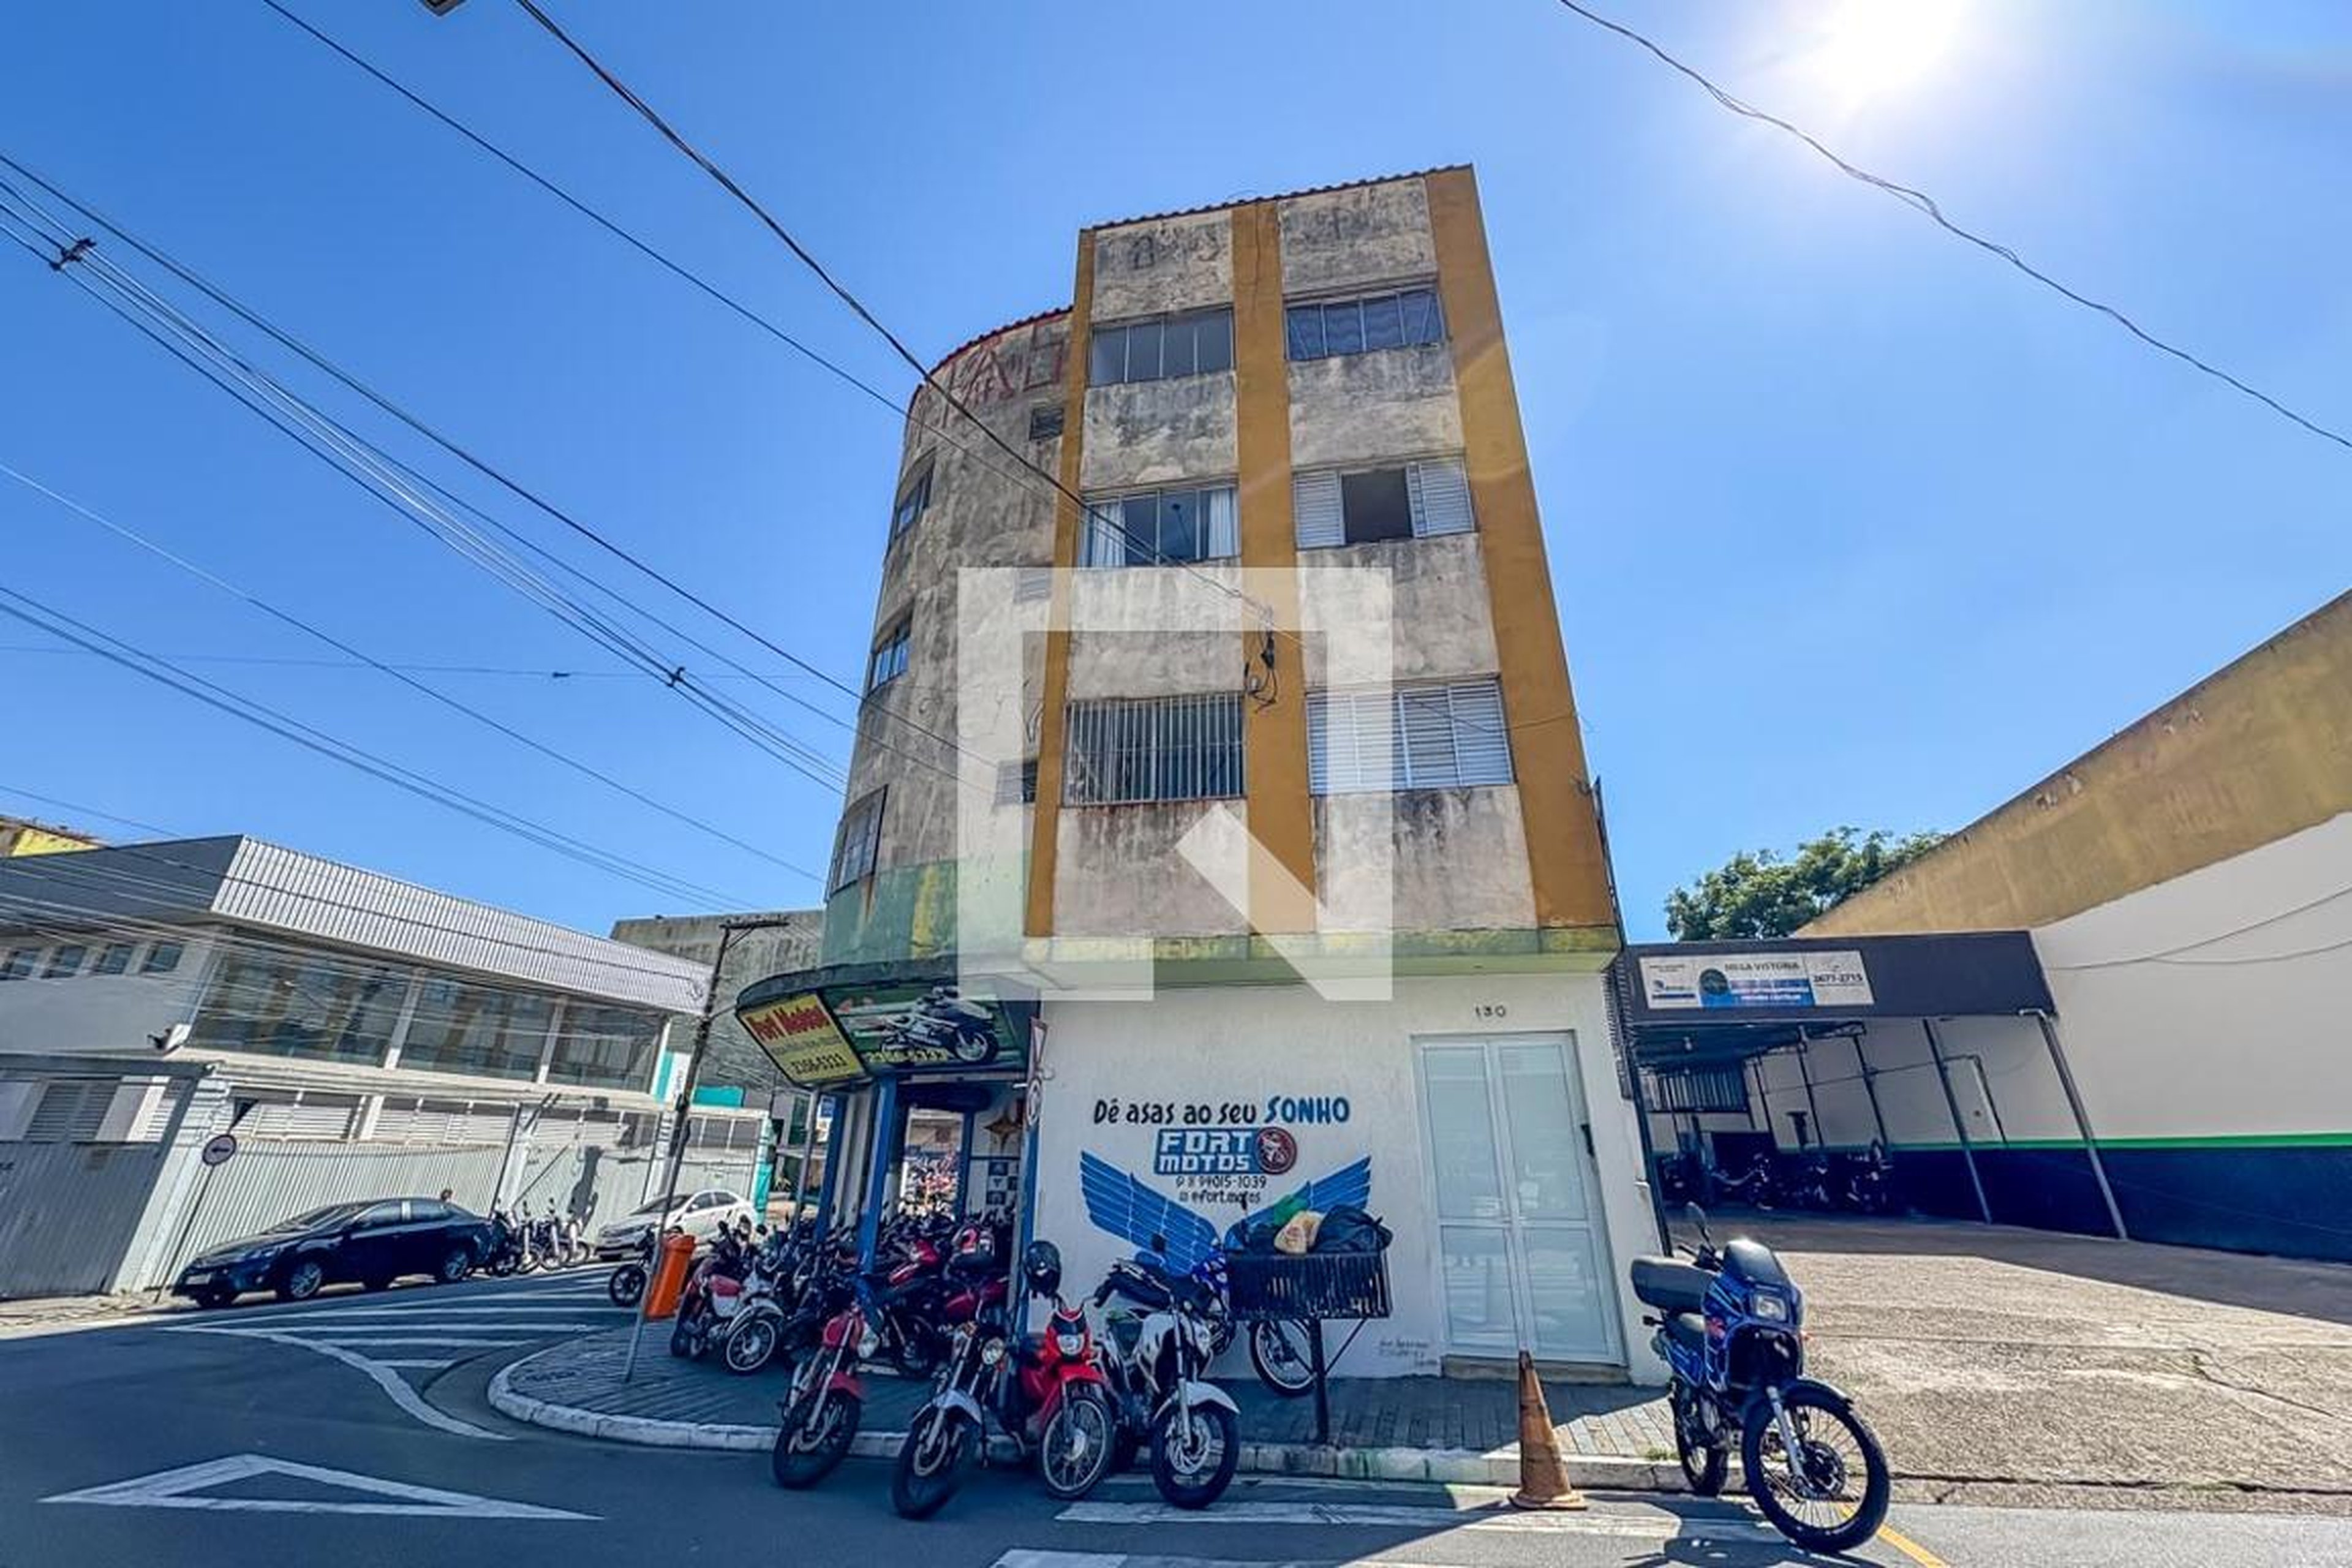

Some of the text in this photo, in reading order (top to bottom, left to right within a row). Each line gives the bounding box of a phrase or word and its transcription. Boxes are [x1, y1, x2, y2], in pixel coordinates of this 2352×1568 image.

[1474, 1005, 1507, 1017] 130
[1126, 1101, 1174, 1124] asas
[1183, 1104, 1212, 1125] ao
[1216, 1102, 1257, 1124] seu
[1264, 1096, 1351, 1125] SONHO
[1160, 1131, 1253, 1153] FORT
